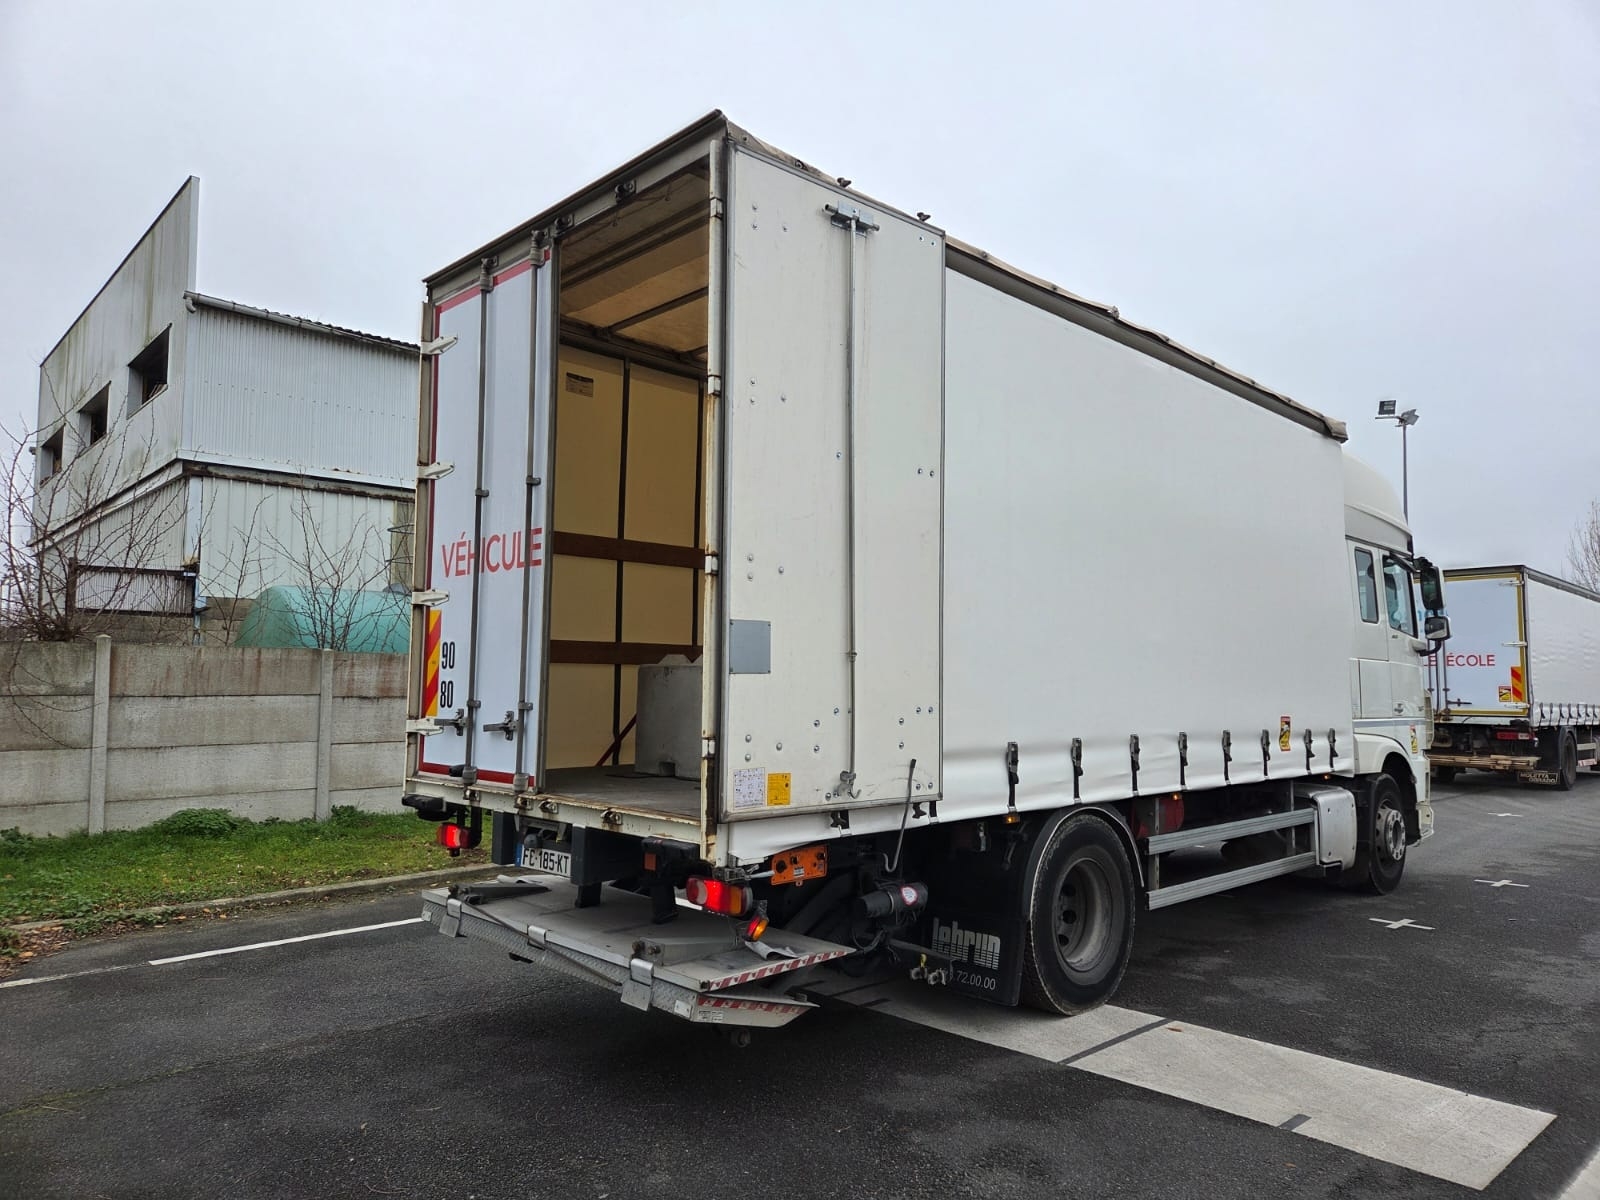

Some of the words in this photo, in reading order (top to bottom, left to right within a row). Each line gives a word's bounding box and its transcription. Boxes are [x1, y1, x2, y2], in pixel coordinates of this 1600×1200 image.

[441, 641, 455, 669] 90
[1446, 652, 1495, 666] ÉCOLE
[440, 680, 454, 708] 80
